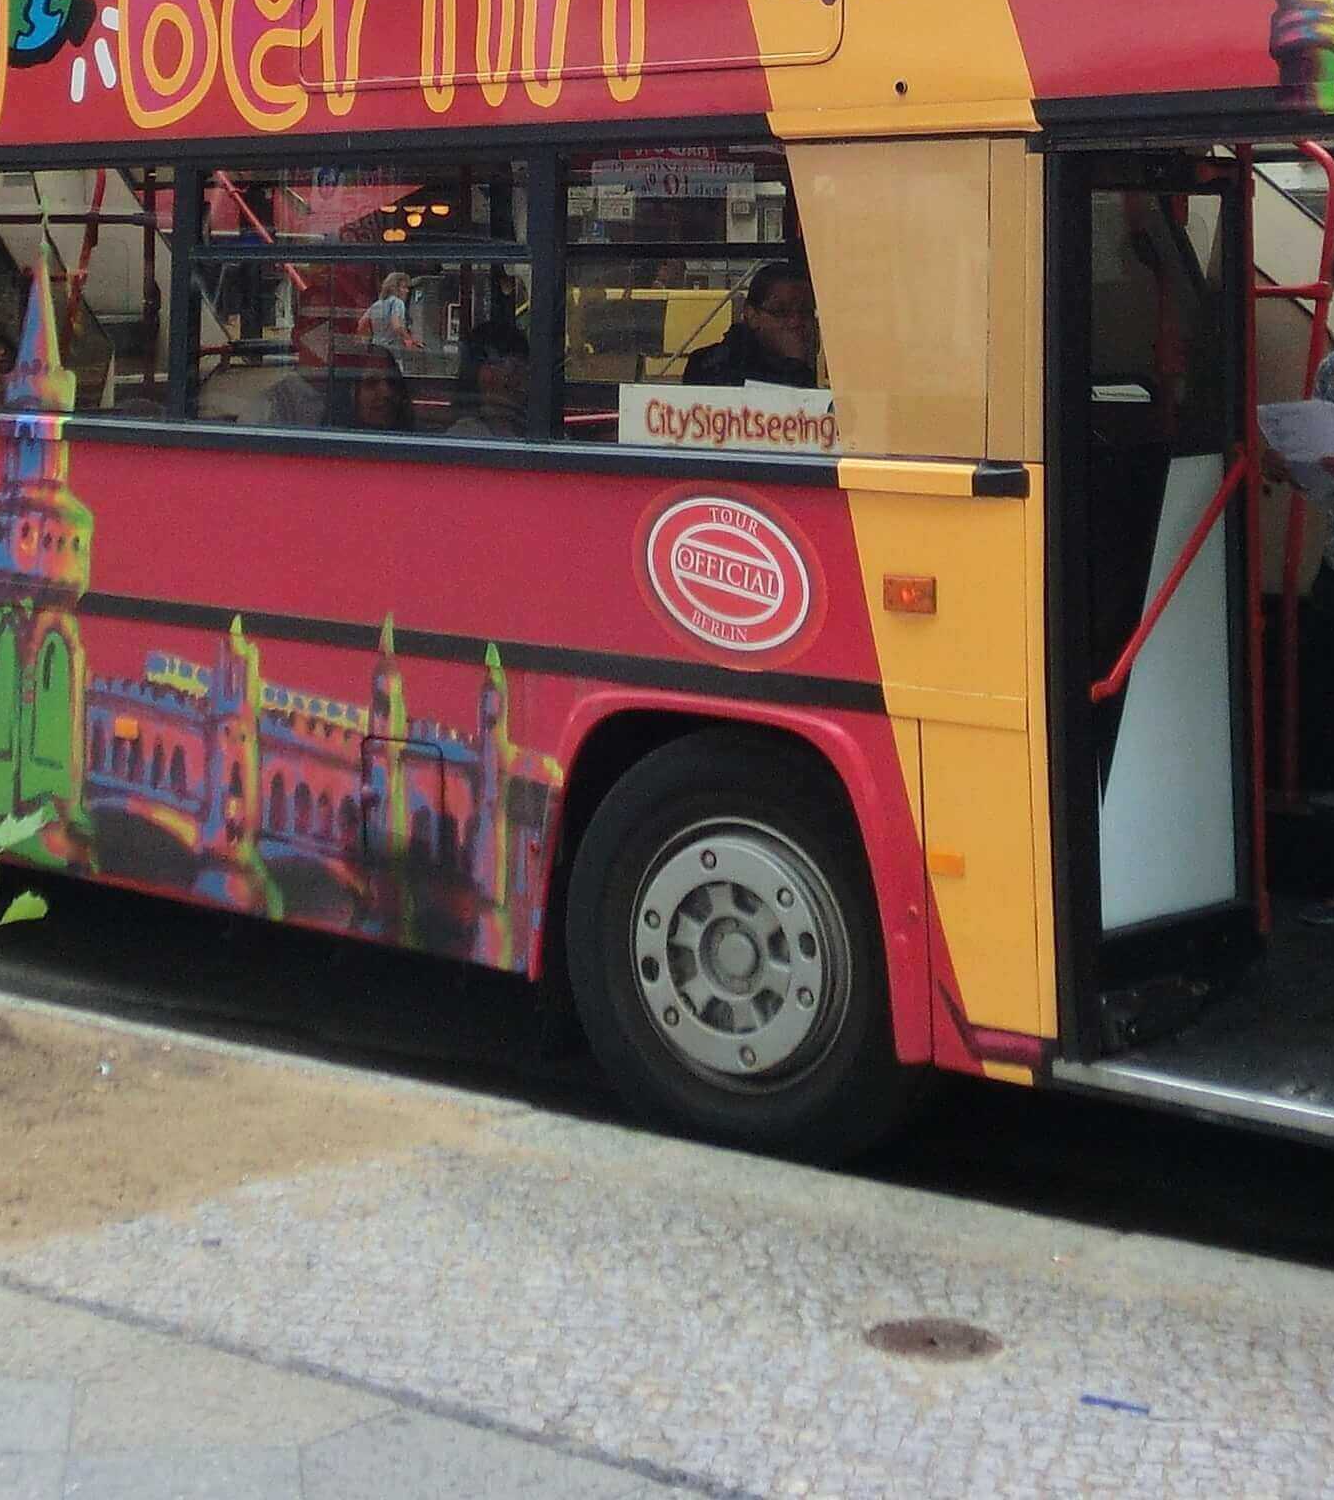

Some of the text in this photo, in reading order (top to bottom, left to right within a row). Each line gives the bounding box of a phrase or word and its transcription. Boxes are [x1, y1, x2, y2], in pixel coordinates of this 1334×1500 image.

[709, 507, 759, 536] TOUR
[677, 546, 777, 598] OFFICIAL
[692, 609, 748, 642] BERLIN
